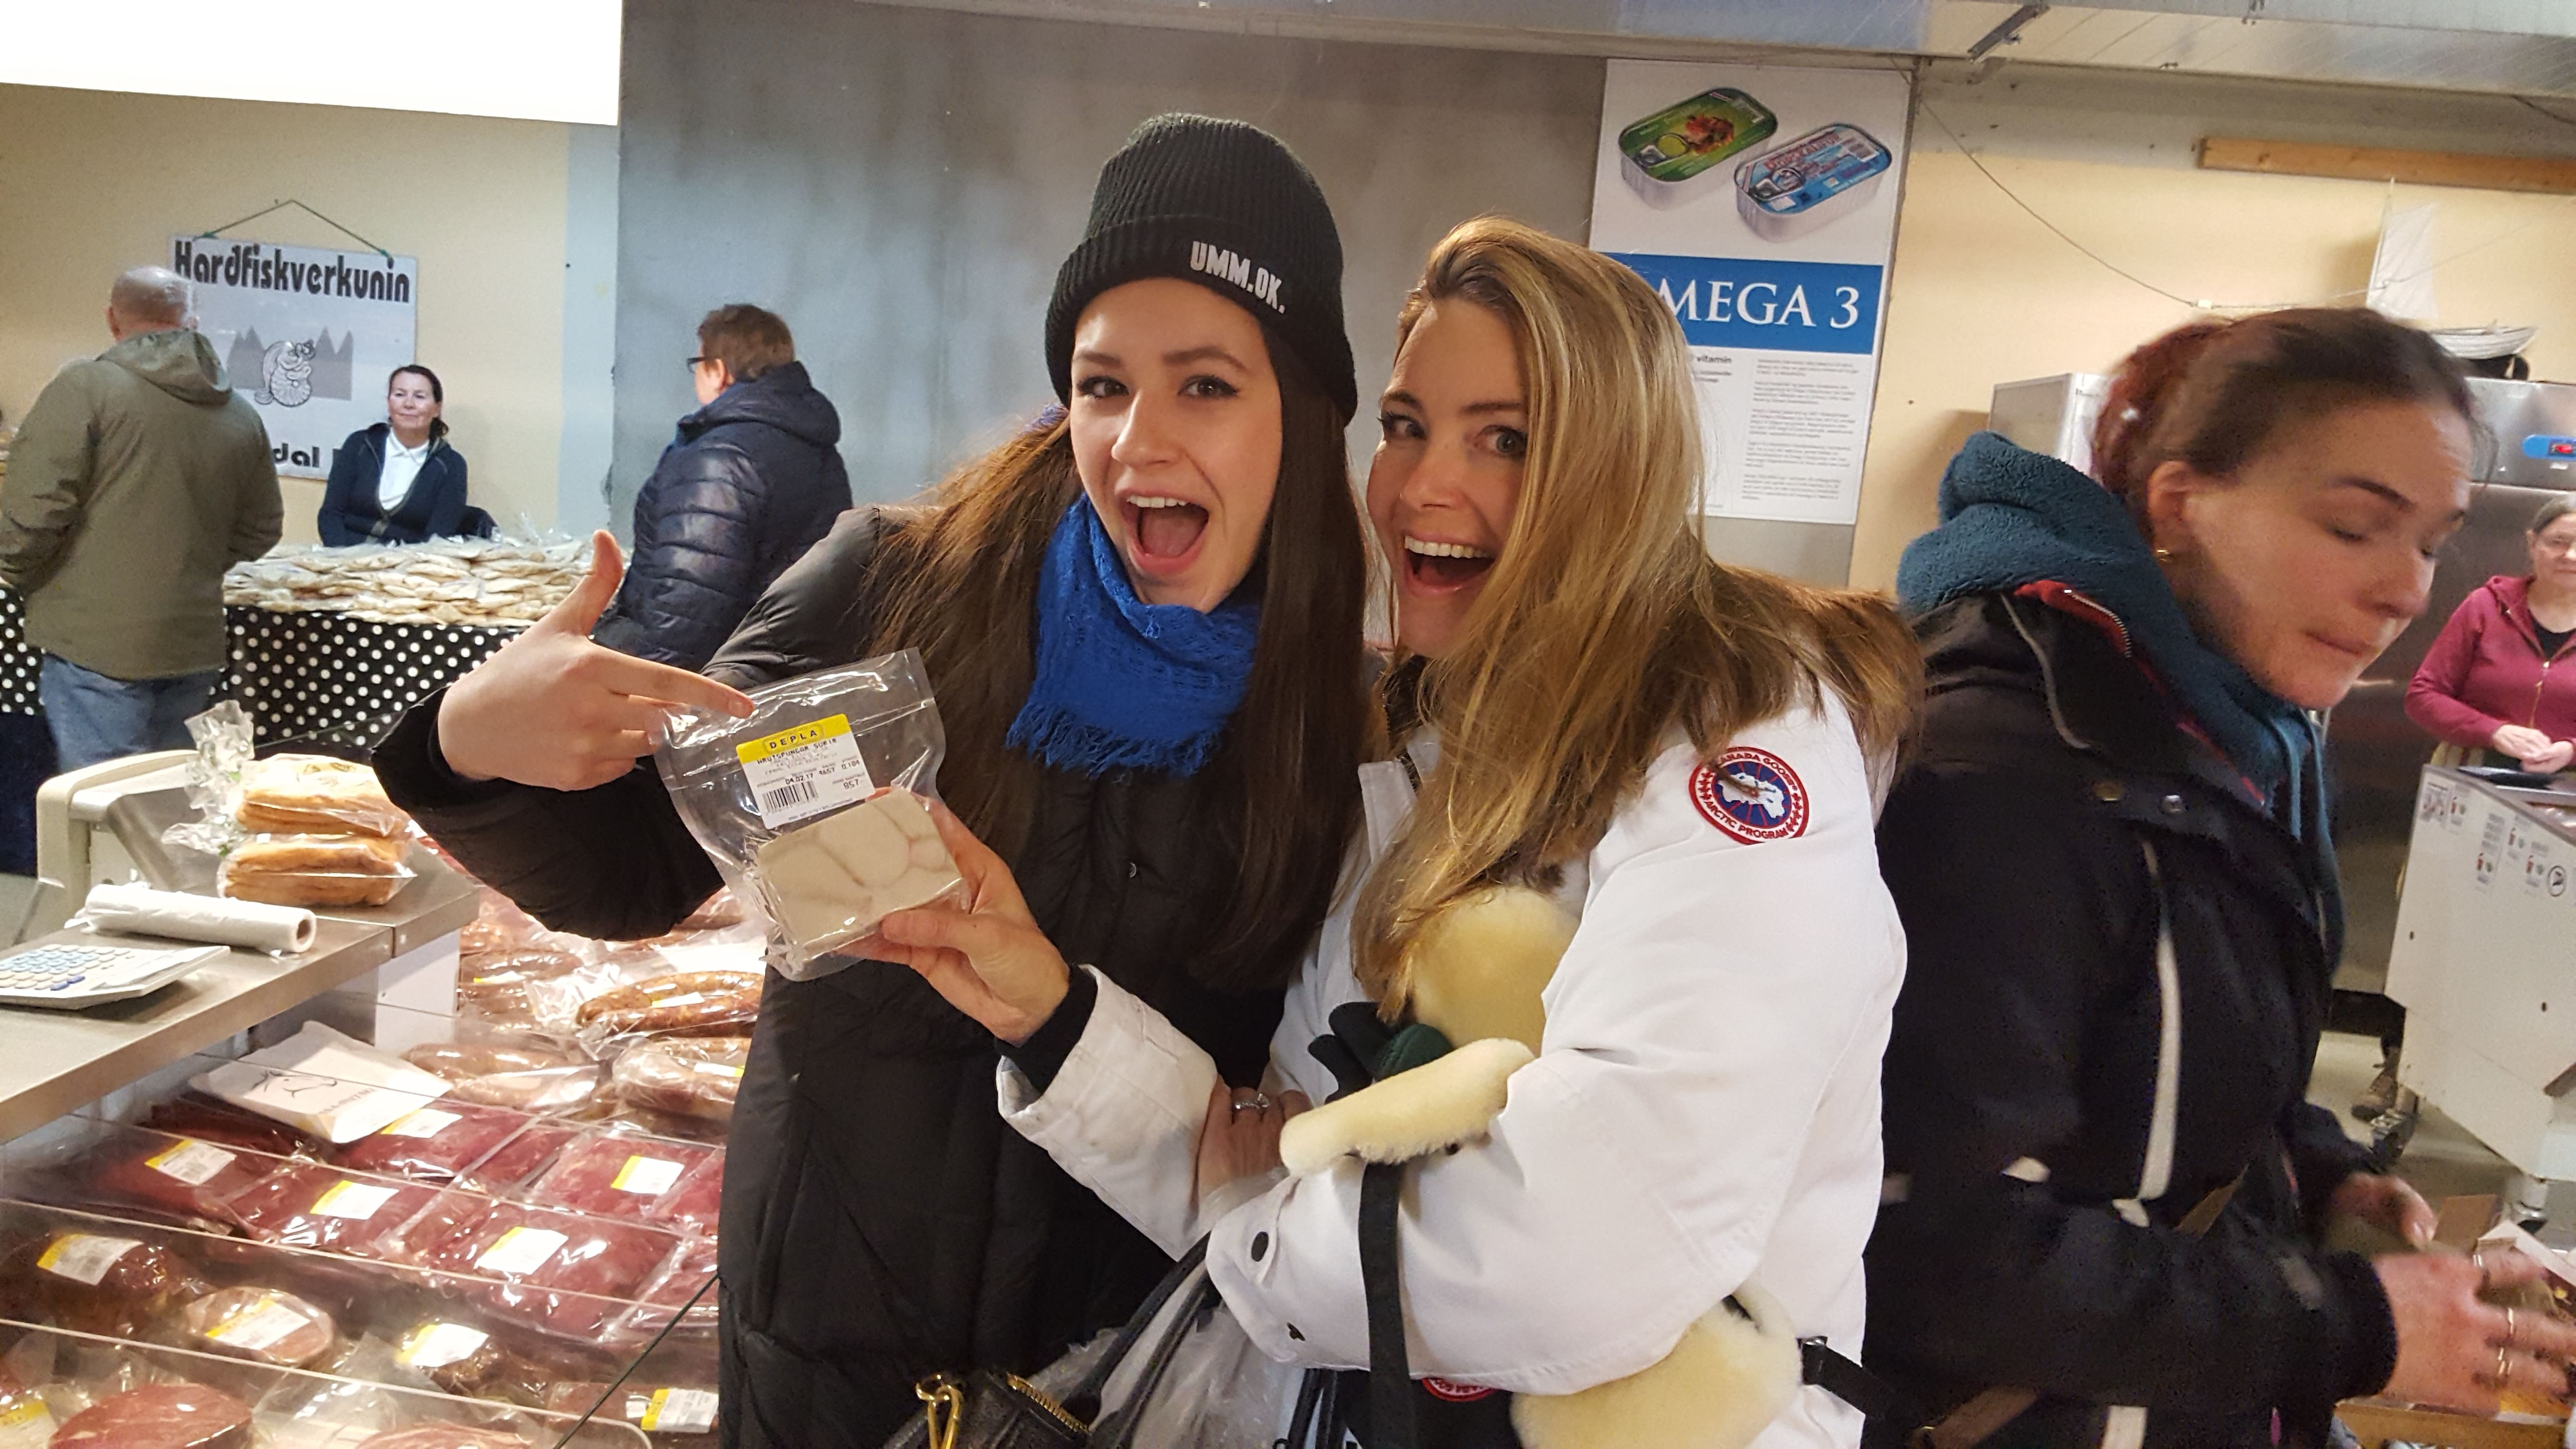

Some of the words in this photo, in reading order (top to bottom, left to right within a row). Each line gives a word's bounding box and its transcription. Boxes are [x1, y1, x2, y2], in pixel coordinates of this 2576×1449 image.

[1190, 241, 1285, 314] UMM.OK.
[1658, 278, 1817, 327] MEGA
[1830, 286, 1859, 329] 3
[1696, 355, 1731, 364] vitamin
[273, 442, 320, 467] dal
[769, 730, 817, 749] DEPLA
[1720, 753, 1761, 762] ANADA
[1763, 758, 1795, 786] GOOSE
[1705, 801, 1737, 828] ARCTIC
[1738, 825, 1789, 839] PROGRAM
